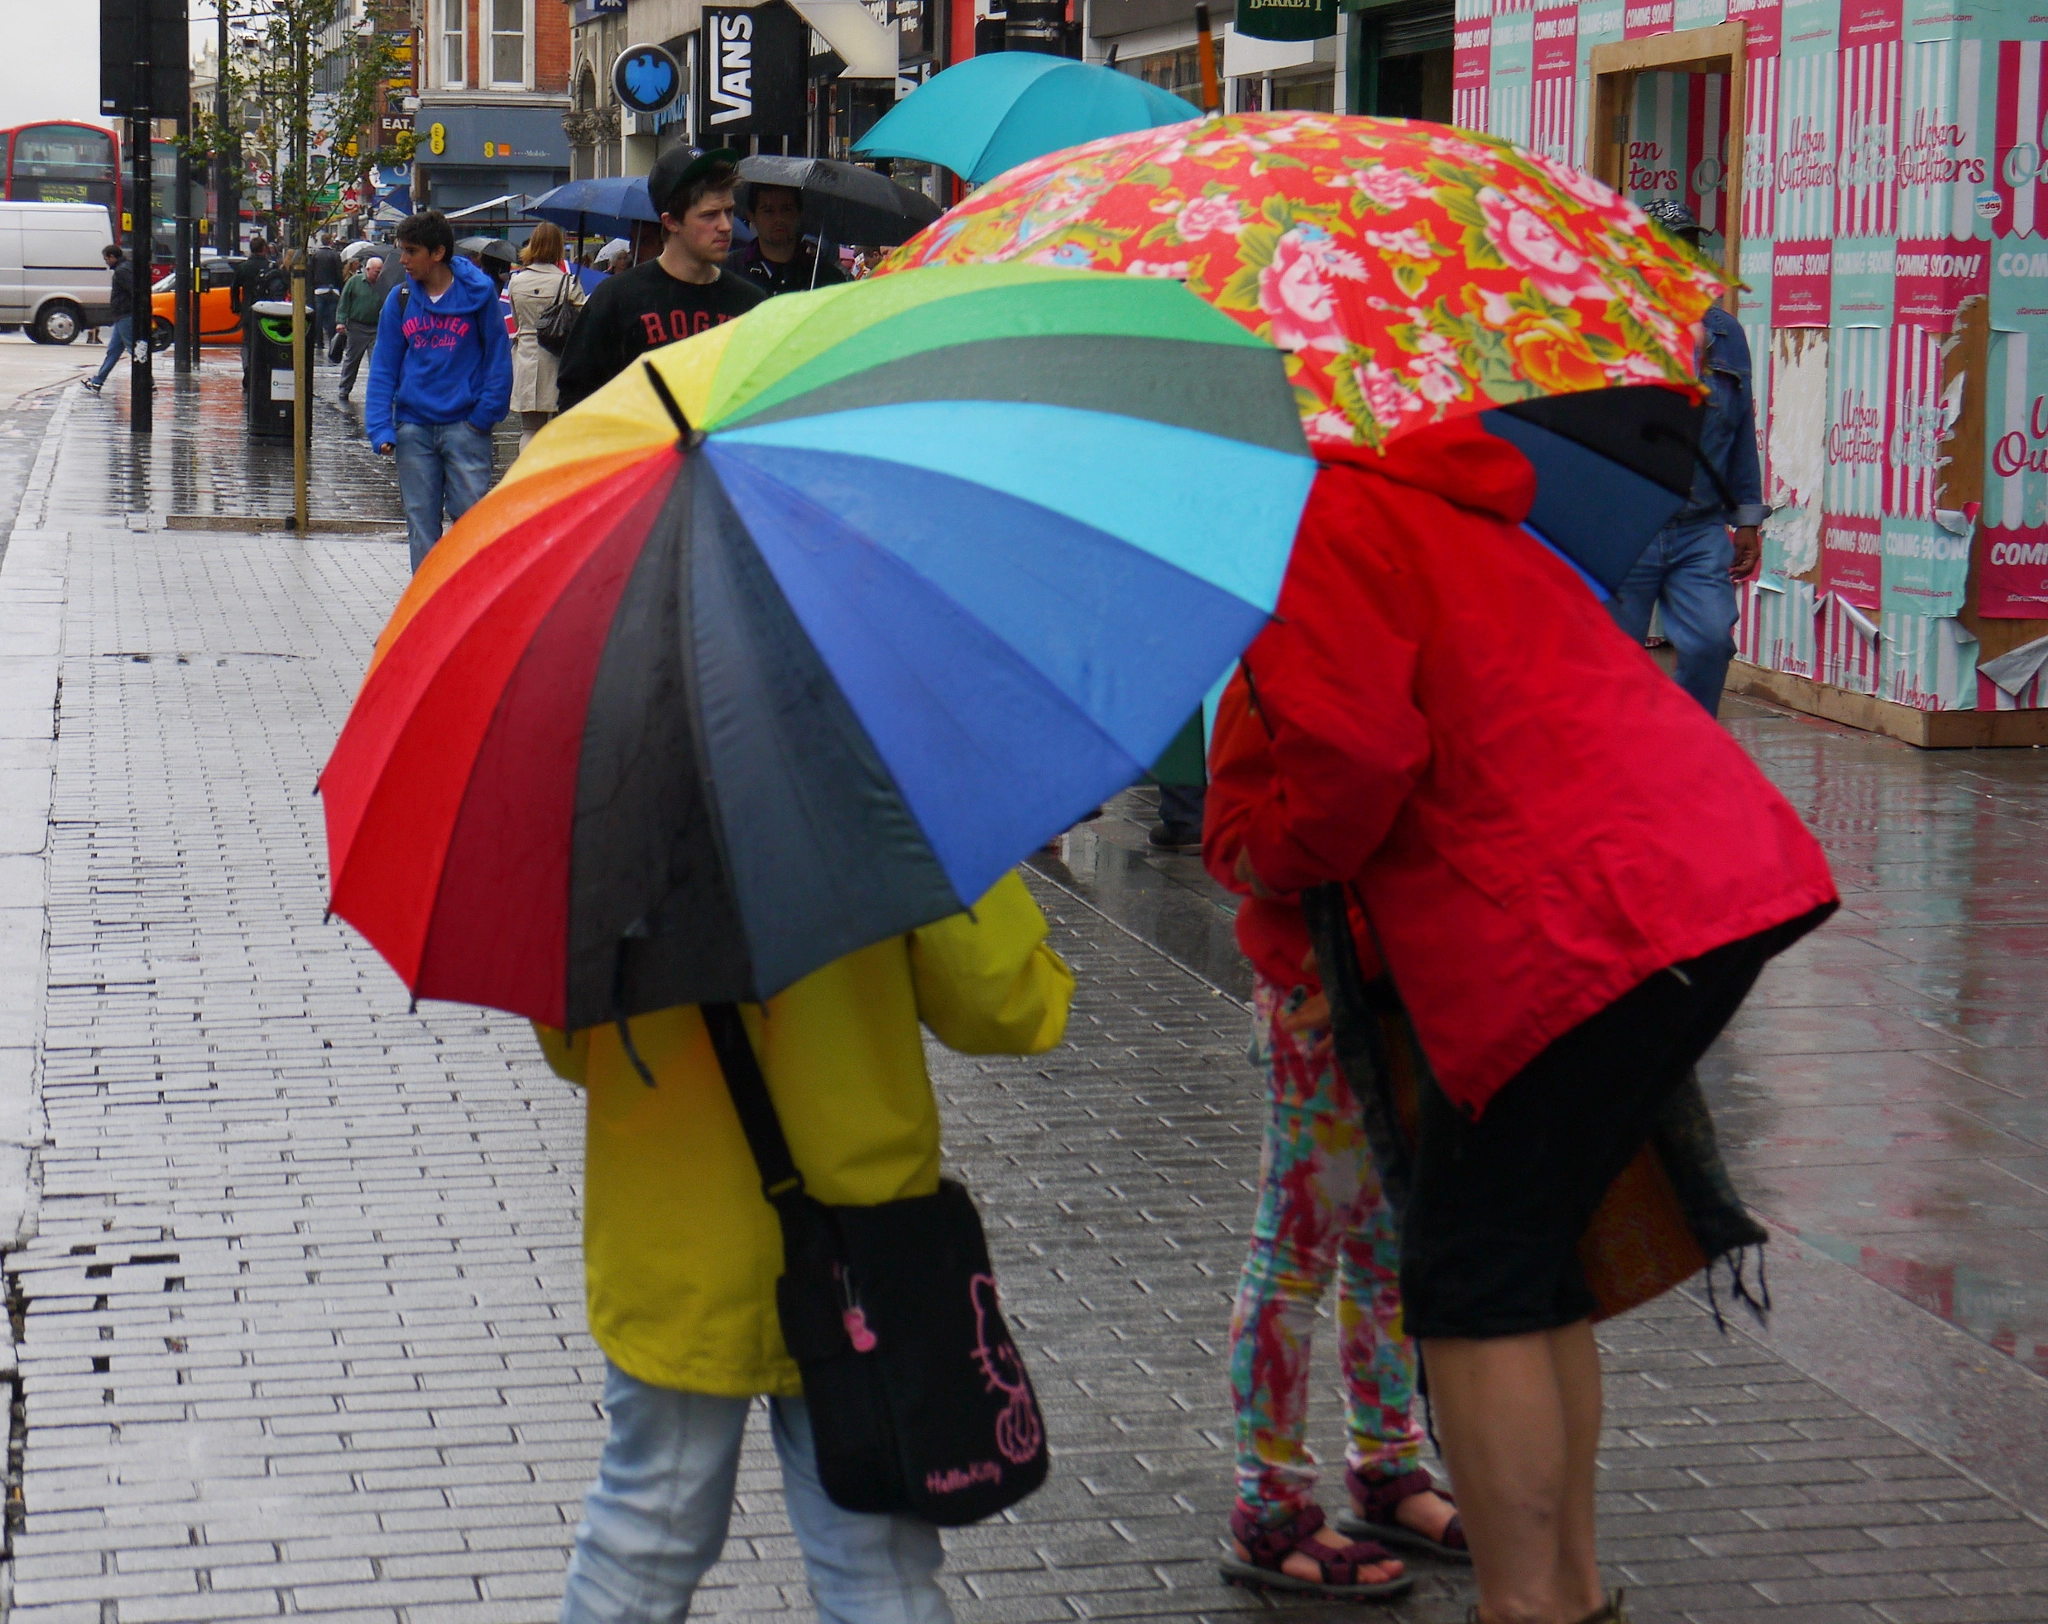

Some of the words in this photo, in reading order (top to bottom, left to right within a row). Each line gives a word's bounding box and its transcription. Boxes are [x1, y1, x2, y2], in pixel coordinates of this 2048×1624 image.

[1535, 20, 1557, 41] COMING
[1558, 16, 1576, 37] SOON!
[1651, 2, 1672, 25] SOON!
[709, 14, 753, 126] VANS
[1790, 116, 1827, 158] Urban
[1914, 107, 1966, 152] Urban
[1778, 152, 1832, 203] Outfitters
[1900, 145, 1986, 200] Outfitters
[1774, 254, 1804, 276] COMING
[1805, 253, 1830, 276] SOON!
[1895, 254, 1928, 277] COMING
[1930, 254, 1981, 279] SOON!
[402, 315, 469, 338] HOLLISTER
[640, 309, 737, 345] ROG
[1842, 388, 1879, 432] Urban
[1825, 528, 1856, 551] COMING
